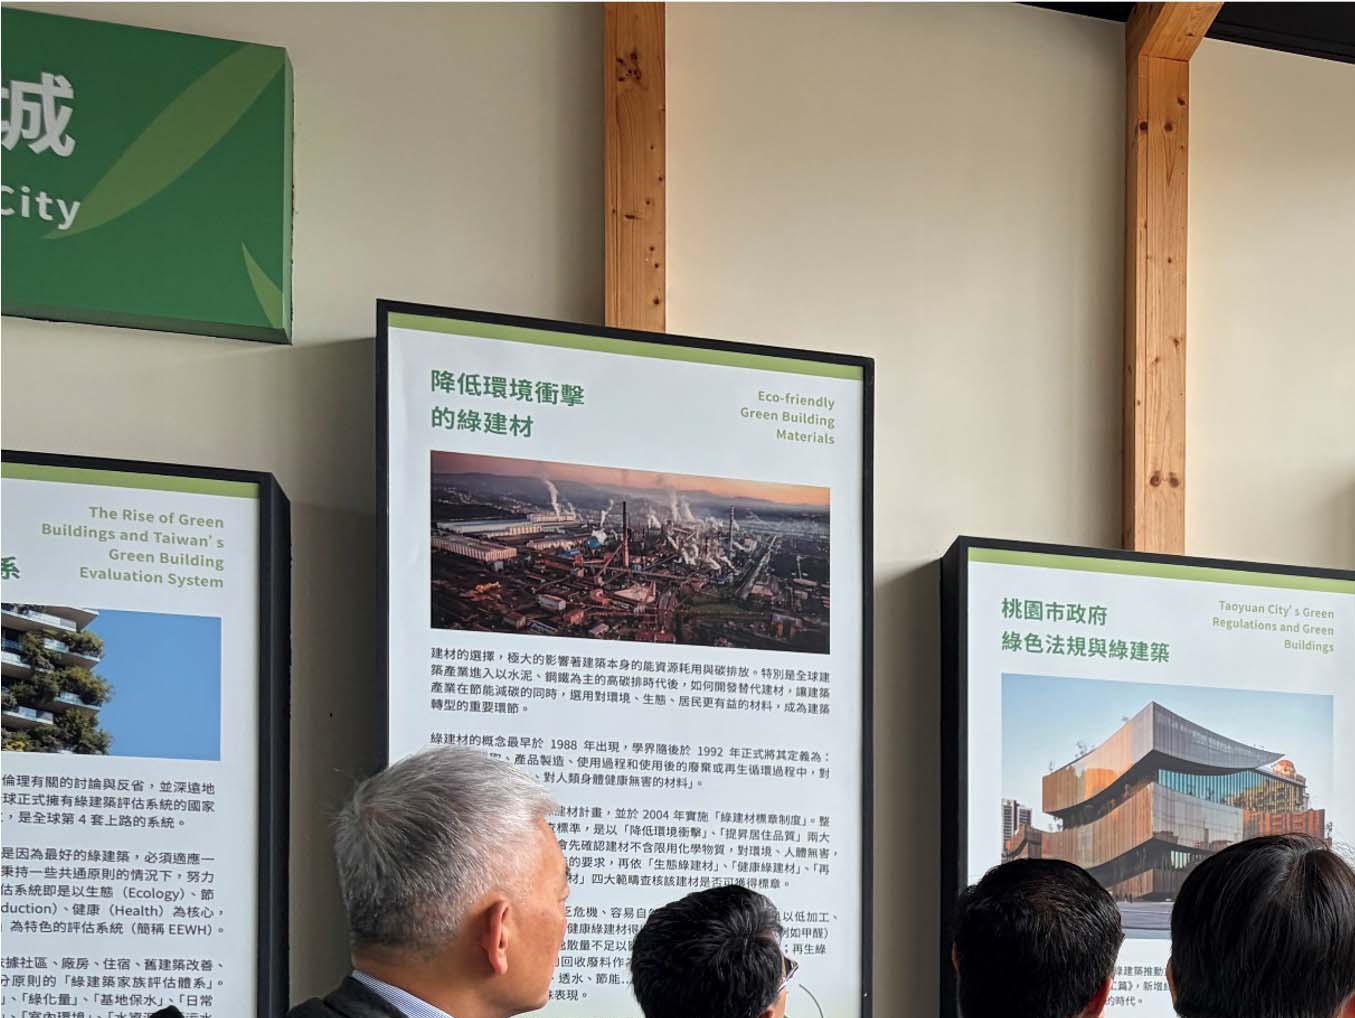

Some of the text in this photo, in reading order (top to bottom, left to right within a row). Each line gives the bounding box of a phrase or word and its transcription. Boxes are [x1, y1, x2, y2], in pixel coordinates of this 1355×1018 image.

[1, 71, 76, 158] 城
[1, 185, 80, 230] City
[430, 369, 585, 406] 降低環境衝擊
[757, 390, 835, 411] Eco-friendly
[430, 406, 534, 438] 的綠建材
[740, 407, 835, 429] Green Building
[776, 428, 835, 446] Materials
[89, 506, 224, 529] The Rise of Green
[42, 523, 116, 542] Buildings
[120, 528, 148, 542] and
[109, 548, 224, 571] Green Building
[80, 566, 224, 589] Evaluation System
[1001, 598, 1108, 626] 桃園市政府
[1218, 600, 1265, 617] Taoyuan
[1303, 607, 1335, 619] Green
[1212, 617, 1335, 636] Regulations and Green
[1001, 631, 1170, 663] 綠色法規與綠建築
[1284, 639, 1335, 653] Buildings
[431, 698, 528, 715] 轉型的重要環節。
[551, 739, 578, 751] 1988
[697, 746, 724, 758] 1992
[489, 751, 830, 780] 、產品製造、使用過程和使用後的廢棄或再生循環過程中，對
[2, 775, 215, 796] 倫理有關的討論與反省，並深遠地
[1, 811, 185, 830] ，是全球第 4 套上路的系統。
[550, 806, 638, 821] 建材計畫，並於
[643, 809, 670, 821] 2004
[1, 920, 165, 936] 為特色的評估系統（簡稱
[777, 911, 838, 924] 以低加工、
